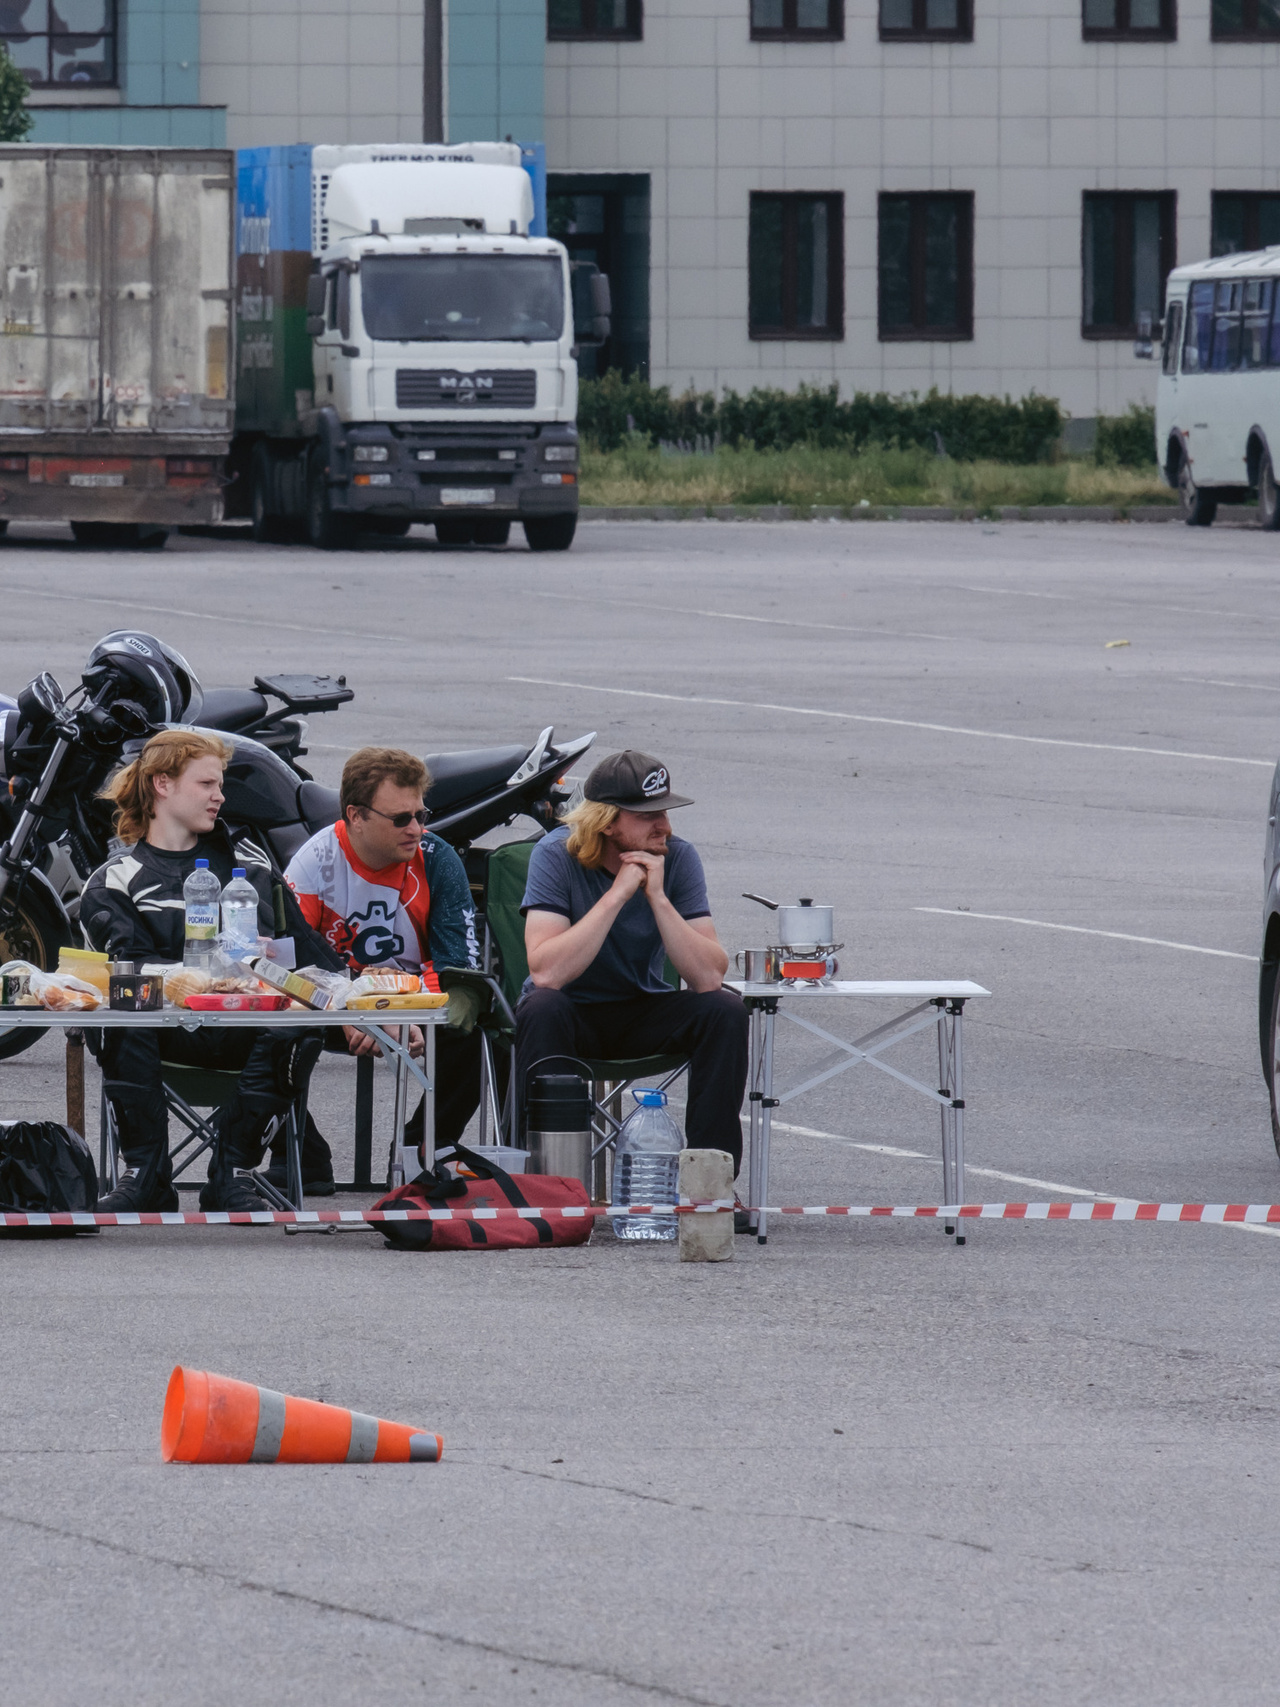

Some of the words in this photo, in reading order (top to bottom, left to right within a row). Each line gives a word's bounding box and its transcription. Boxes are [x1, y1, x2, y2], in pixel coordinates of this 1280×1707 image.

[371, 155, 434, 163] THERMO
[438, 155, 475, 163] KING
[439, 376, 493, 388] MAN
[128, 639, 150, 655] SHOEI
[188, 916, 214, 925] РОСИНКА
